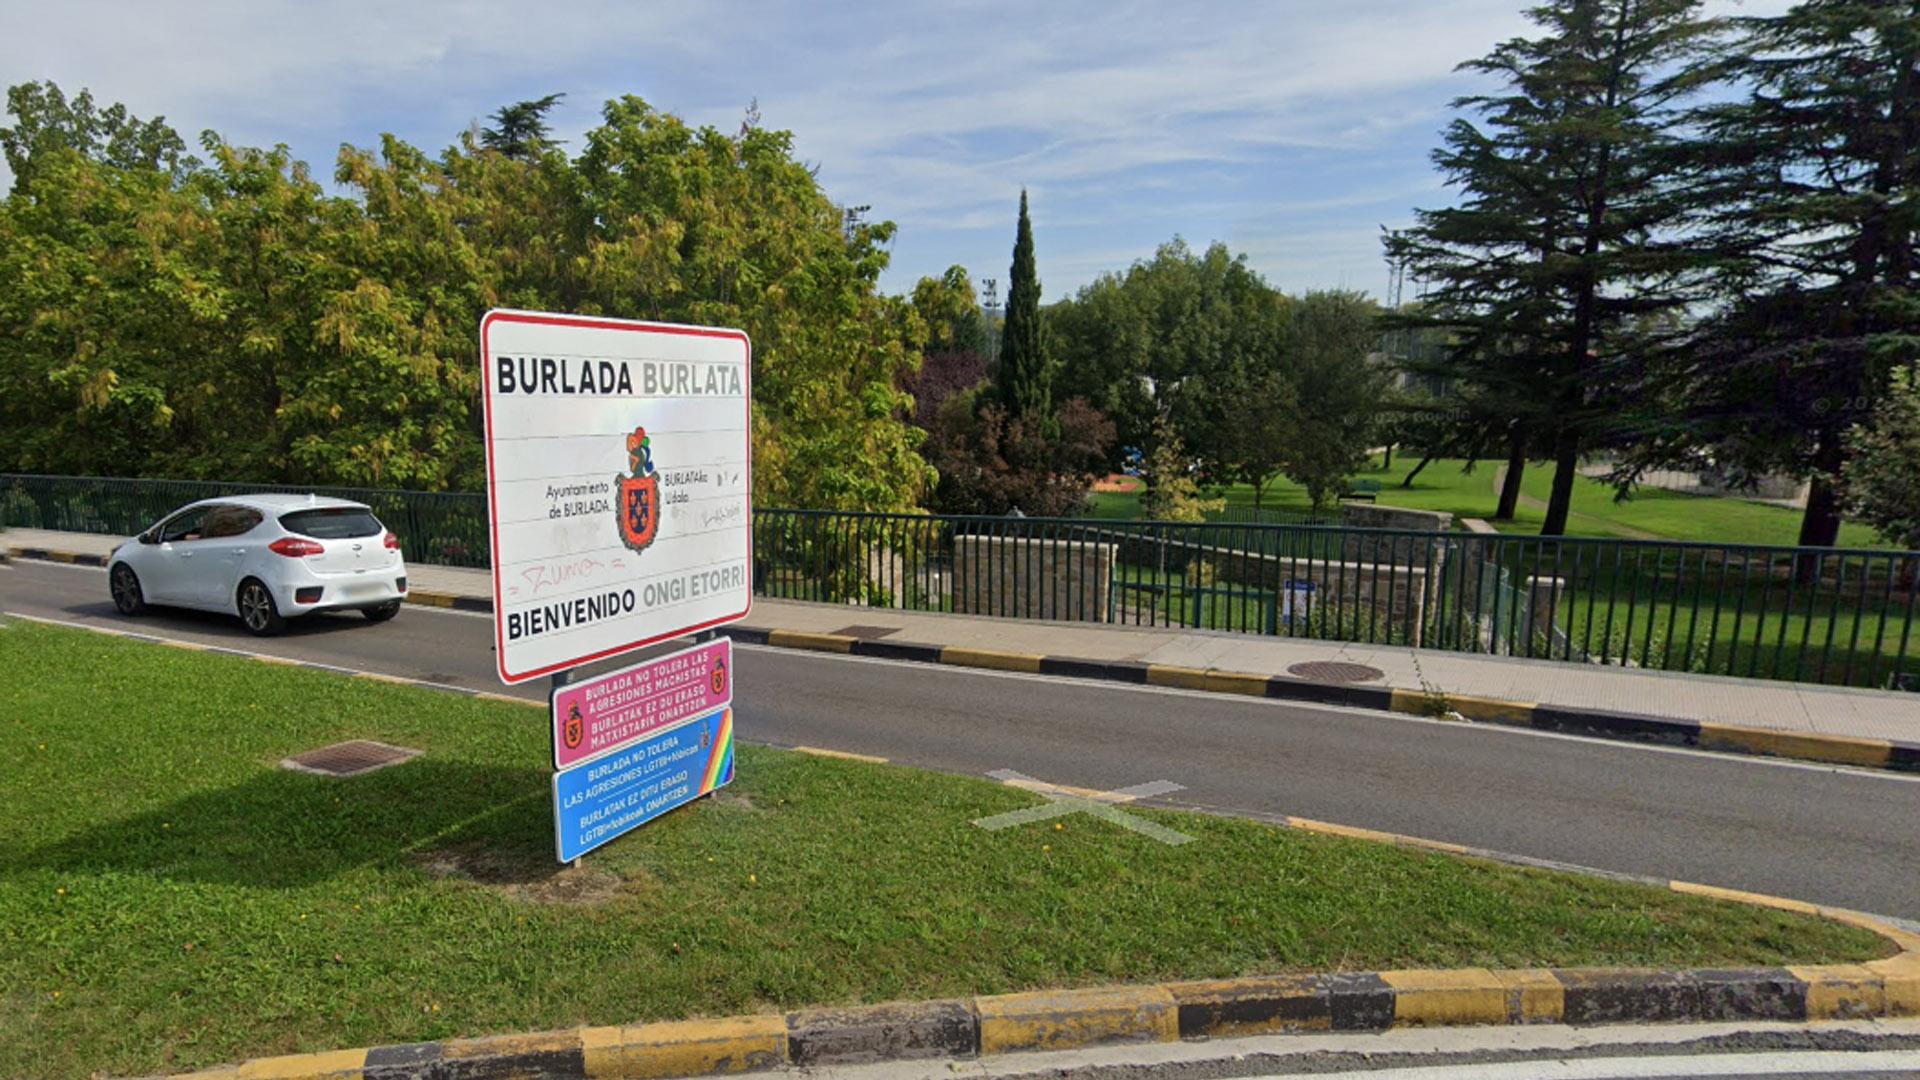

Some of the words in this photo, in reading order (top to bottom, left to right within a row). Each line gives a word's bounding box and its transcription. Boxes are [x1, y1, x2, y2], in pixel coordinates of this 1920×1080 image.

[497, 357, 632, 395] BURLADA
[643, 363, 741, 395] BURLATA
[545, 481, 609, 502] Ayuntamiento
[549, 503, 562, 520] de
[564, 499, 609, 518] BURLADA
[507, 588, 635, 640] BIENVENIDO
[643, 577, 686, 607] ONGI
[691, 565, 745, 596] ETORRI
[586, 676, 632, 702] BURLADA
[635, 671, 650, 683] NO
[653, 658, 689, 678] TOLERA
[692, 651, 709, 666] LAS
[589, 684, 653, 715] AGRESIONES
[655, 665, 707, 690] MACHISTAS
[591, 706, 643, 735] BURLATAK
[646, 701, 658, 715] EZ
[675, 684, 706, 704] ERASO
[591, 716, 655, 750] MATXISTARIK
[659, 697, 707, 723] ONARTZEN
[587, 756, 632, 782] BURLADA
[632, 750, 646, 764] NO
[647, 736, 679, 756] TOLERA
[563, 792, 583, 810] LAS
[585, 766, 643, 803] AGRESIONES
[580, 798, 626, 829] BURLATAK
[627, 792, 639, 807] EZ
[660, 770, 688, 791] ERASO
[646, 785, 689, 812] ONARTZEN
